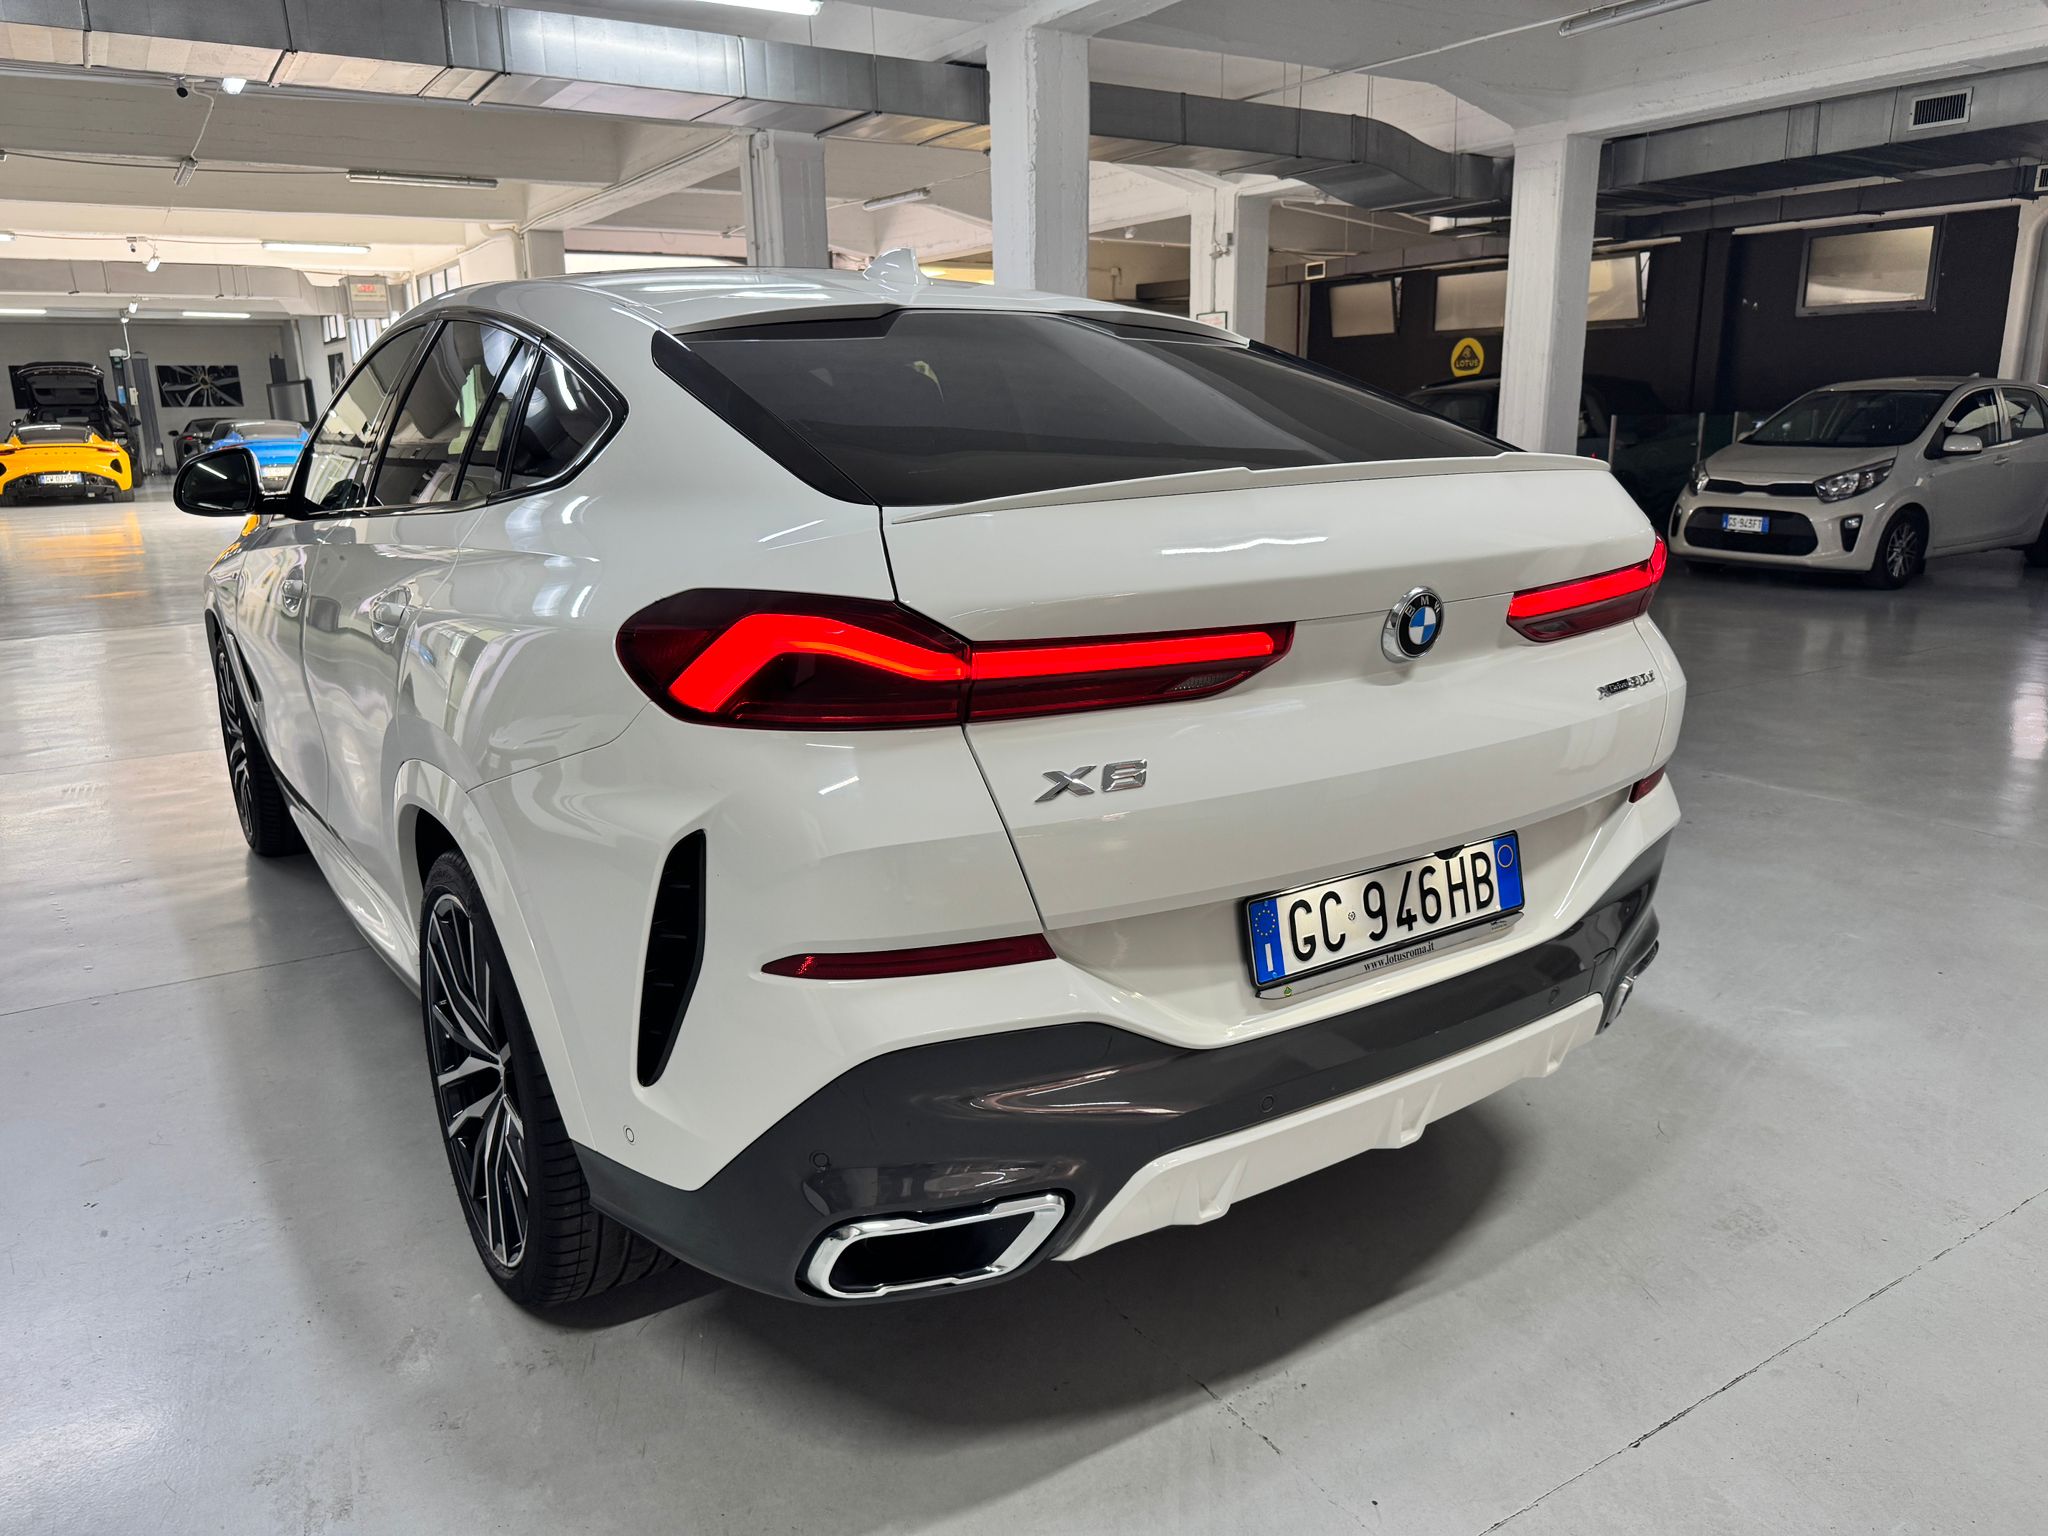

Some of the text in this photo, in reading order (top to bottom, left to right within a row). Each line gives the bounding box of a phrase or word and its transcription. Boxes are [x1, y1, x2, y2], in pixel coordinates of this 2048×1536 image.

[1455, 358, 1479, 369] LOTUS
[1404, 595, 1441, 618] BMW
[1034, 759, 1148, 803] X6
[1288, 890, 1346, 962] GC
[1362, 850, 1495, 942] 946HB
[1363, 941, 1435, 972] www.lotusroma.it
